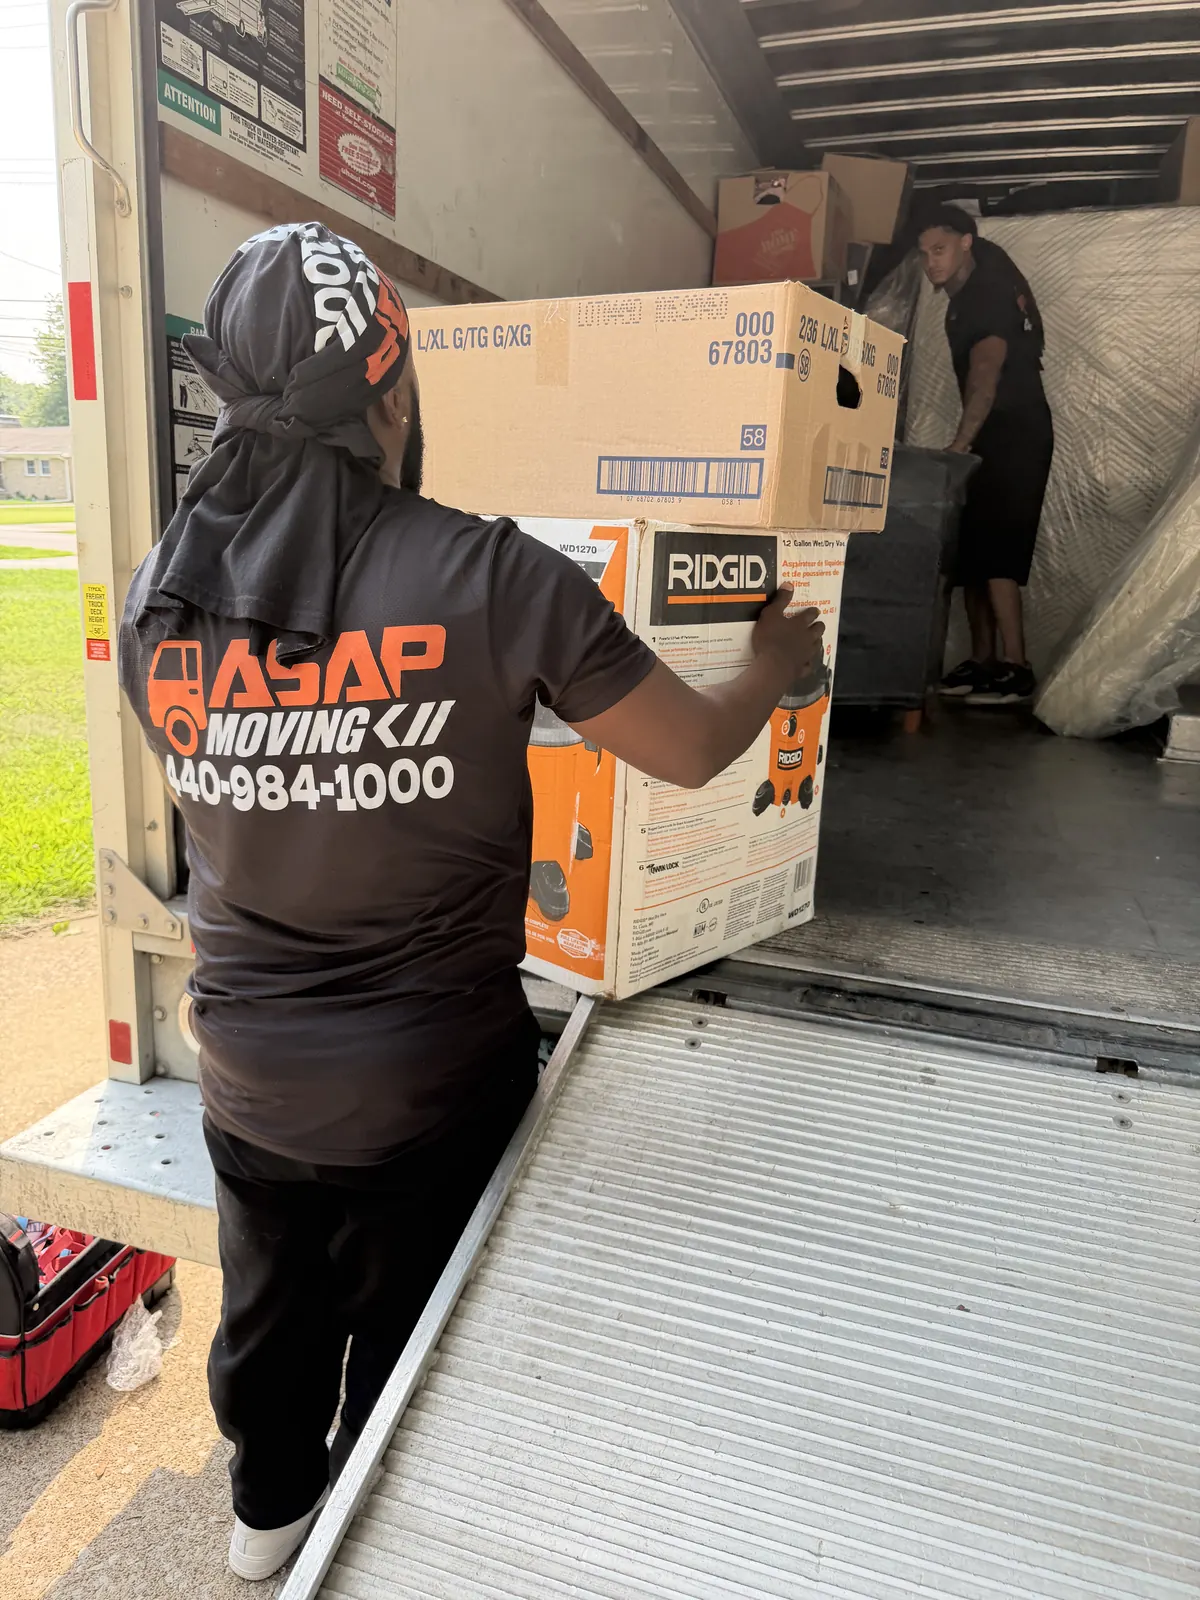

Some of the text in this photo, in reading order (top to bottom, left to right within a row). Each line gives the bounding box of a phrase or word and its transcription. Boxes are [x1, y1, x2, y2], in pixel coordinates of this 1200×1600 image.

[164, 82, 216, 124] ATTENTION
[230, 111, 241, 124] THIS
[242, 118, 257, 133] TRUCK
[256, 127, 262, 136] IS
[322, 90, 394, 146] NEED SELF-STORAGE
[247, 129, 256, 140] NOT
[341, 145, 356, 158] FREE
[735, 311, 775, 337] 000
[798, 314, 819, 344] 2/36
[820, 323, 839, 353] L/XL
[417, 323, 532, 352] L/XL G/TG G/XG
[708, 339, 773, 366] 67803
[799, 353, 810, 376] SB
[887, 353, 899, 376] 000
[877, 373, 897, 399] 67803
[742, 428, 765, 447] 58
[559, 544, 597, 554] WD1270
[793, 539, 812, 547] Gallon
[813, 539, 835, 548] Wet/Dry
[667, 553, 767, 590] RIDGID
[88, 600, 104, 608] TRUCK
[788, 600, 818, 608] spiradora
[208, 624, 447, 709] ASAP
[205, 706, 371, 757] MOVING
[778, 750, 802, 764] RIDGID
[166, 754, 454, 812] 440-984-1000
[788, 901, 811, 919] WD1270
